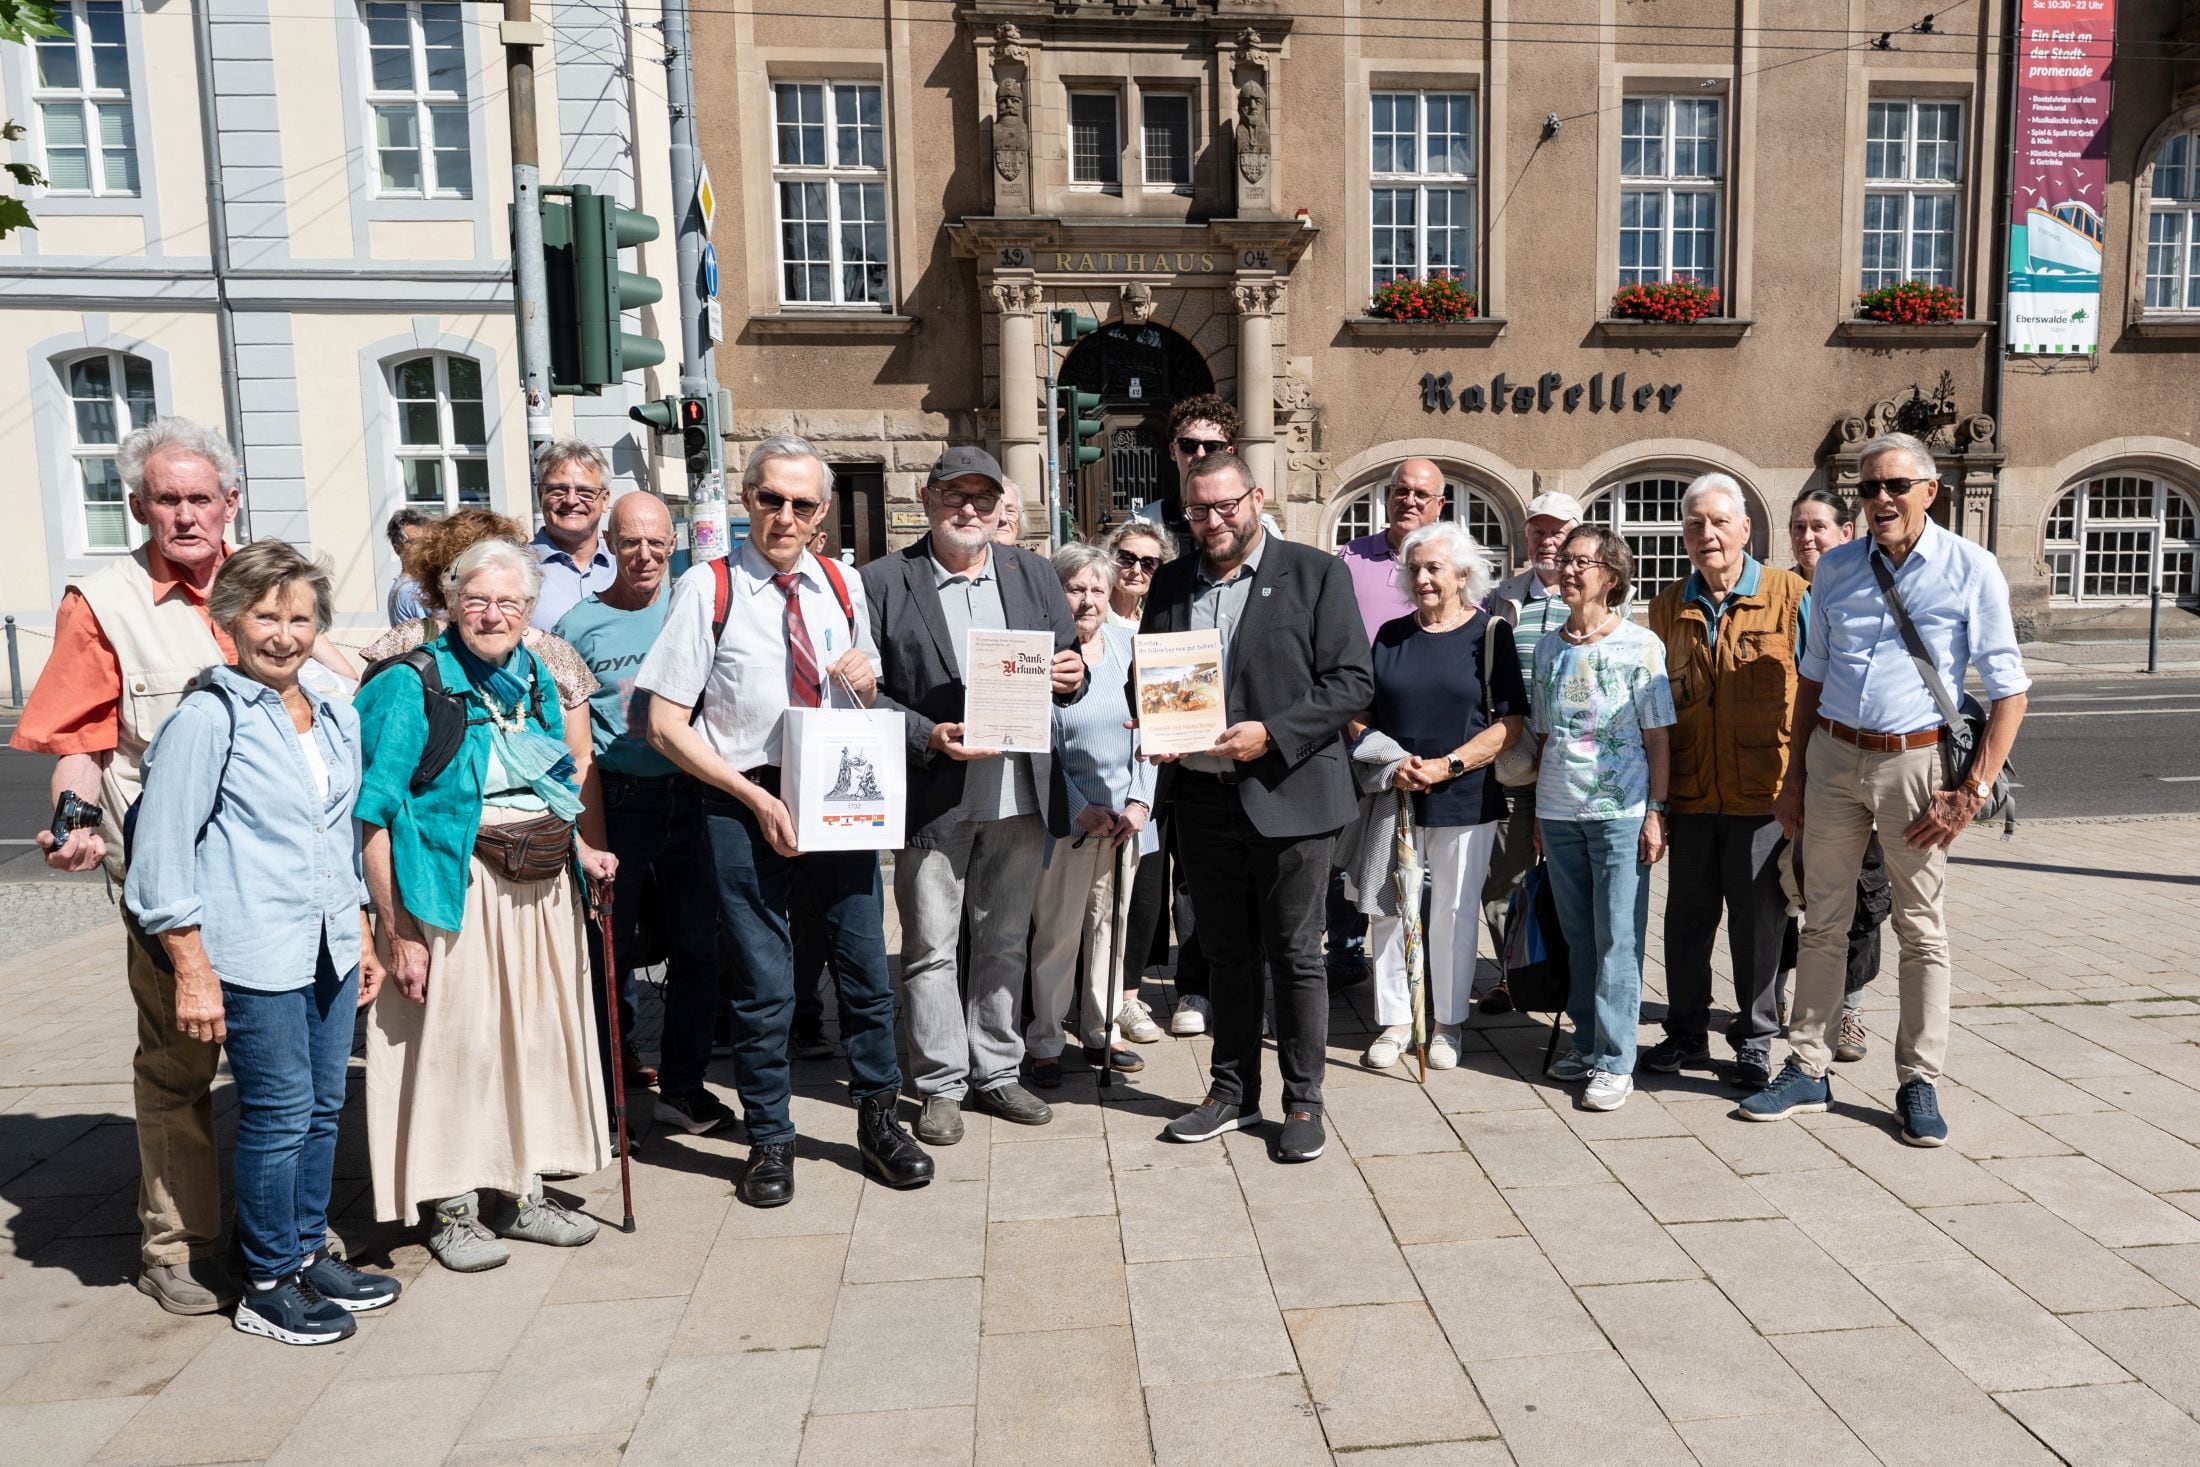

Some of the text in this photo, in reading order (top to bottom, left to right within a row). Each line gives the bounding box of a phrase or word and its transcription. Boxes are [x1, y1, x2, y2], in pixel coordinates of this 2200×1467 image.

[2033, 0, 2046, 9] Sa:
[2088, 0, 2105, 10] Uhr
[2031, 29, 2093, 43] Ein Fest an
[2030, 46, 2087, 60] der Stadt-
[2029, 65, 2094, 78] promenade
[1055, 252, 1215, 272] RATHAUS
[2016, 314, 2068, 324] Eberswalde
[1419, 371, 1682, 414] Ratskeller
[1018, 652, 1046, 664] Dank-
[1001, 659, 1046, 677] Urkunde
